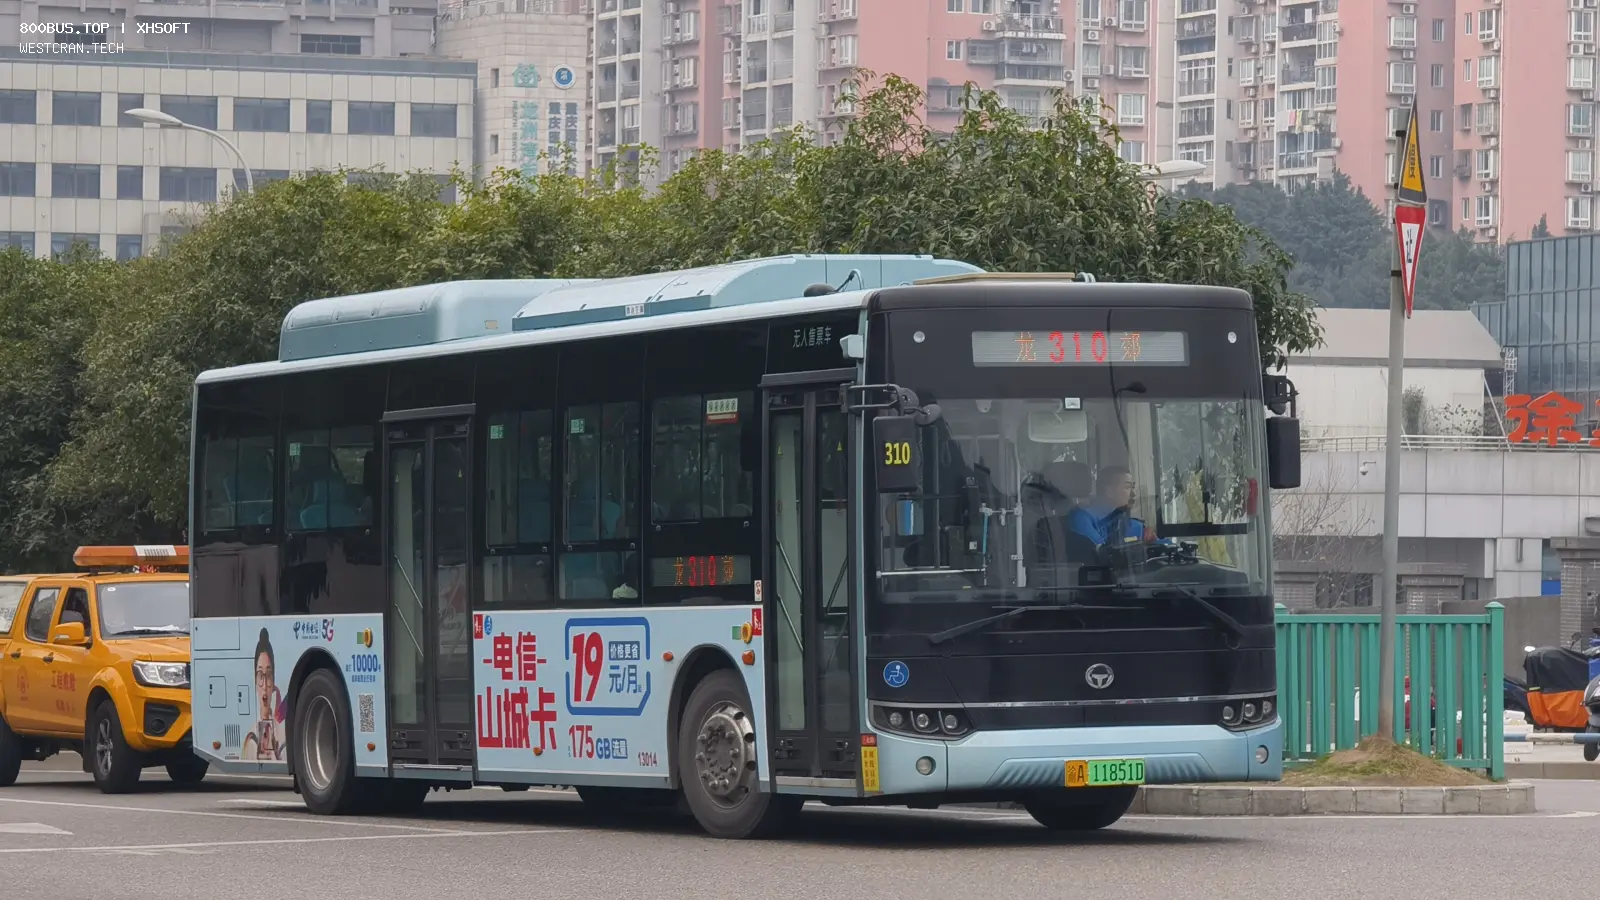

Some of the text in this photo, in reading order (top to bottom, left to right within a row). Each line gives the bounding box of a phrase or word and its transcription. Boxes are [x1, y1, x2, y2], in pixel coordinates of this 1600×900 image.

[793, 326, 832, 348] 无人售票车
[1048, 331, 1107, 364] 310
[1503, 391, 1600, 448] 徐
[885, 442, 911, 465] 310
[688, 555, 717, 587] 310
[321, 617, 335, 642] 5G
[493, 631, 537, 681] 电信
[610, 642, 639, 659] 价格更省
[572, 632, 604, 702] 19
[609, 664, 638, 694] 元/月
[477, 686, 558, 750] 山城卡
[638, 752, 658, 767] 13014
